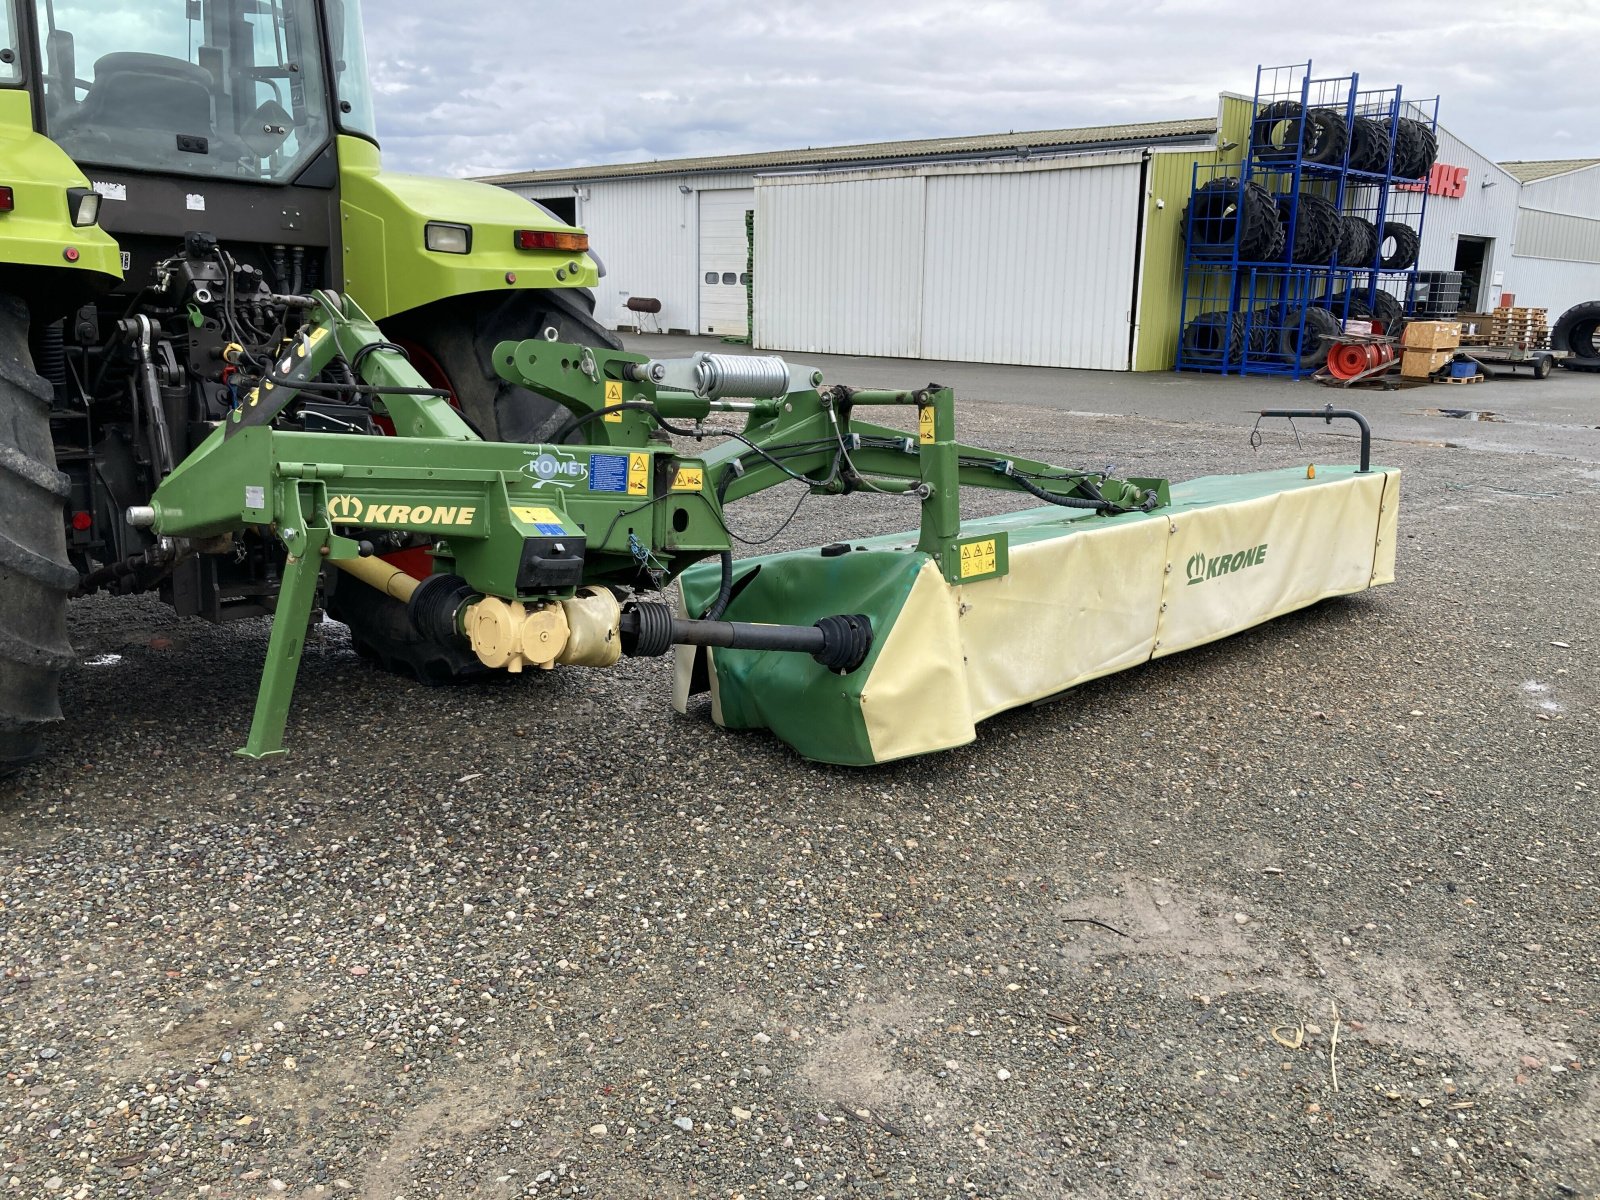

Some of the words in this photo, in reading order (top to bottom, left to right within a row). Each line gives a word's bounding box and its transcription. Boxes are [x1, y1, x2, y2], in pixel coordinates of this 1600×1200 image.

[529, 459, 588, 475] ROMET
[364, 504, 477, 525] KRONE
[1206, 543, 1268, 581] KRONE
